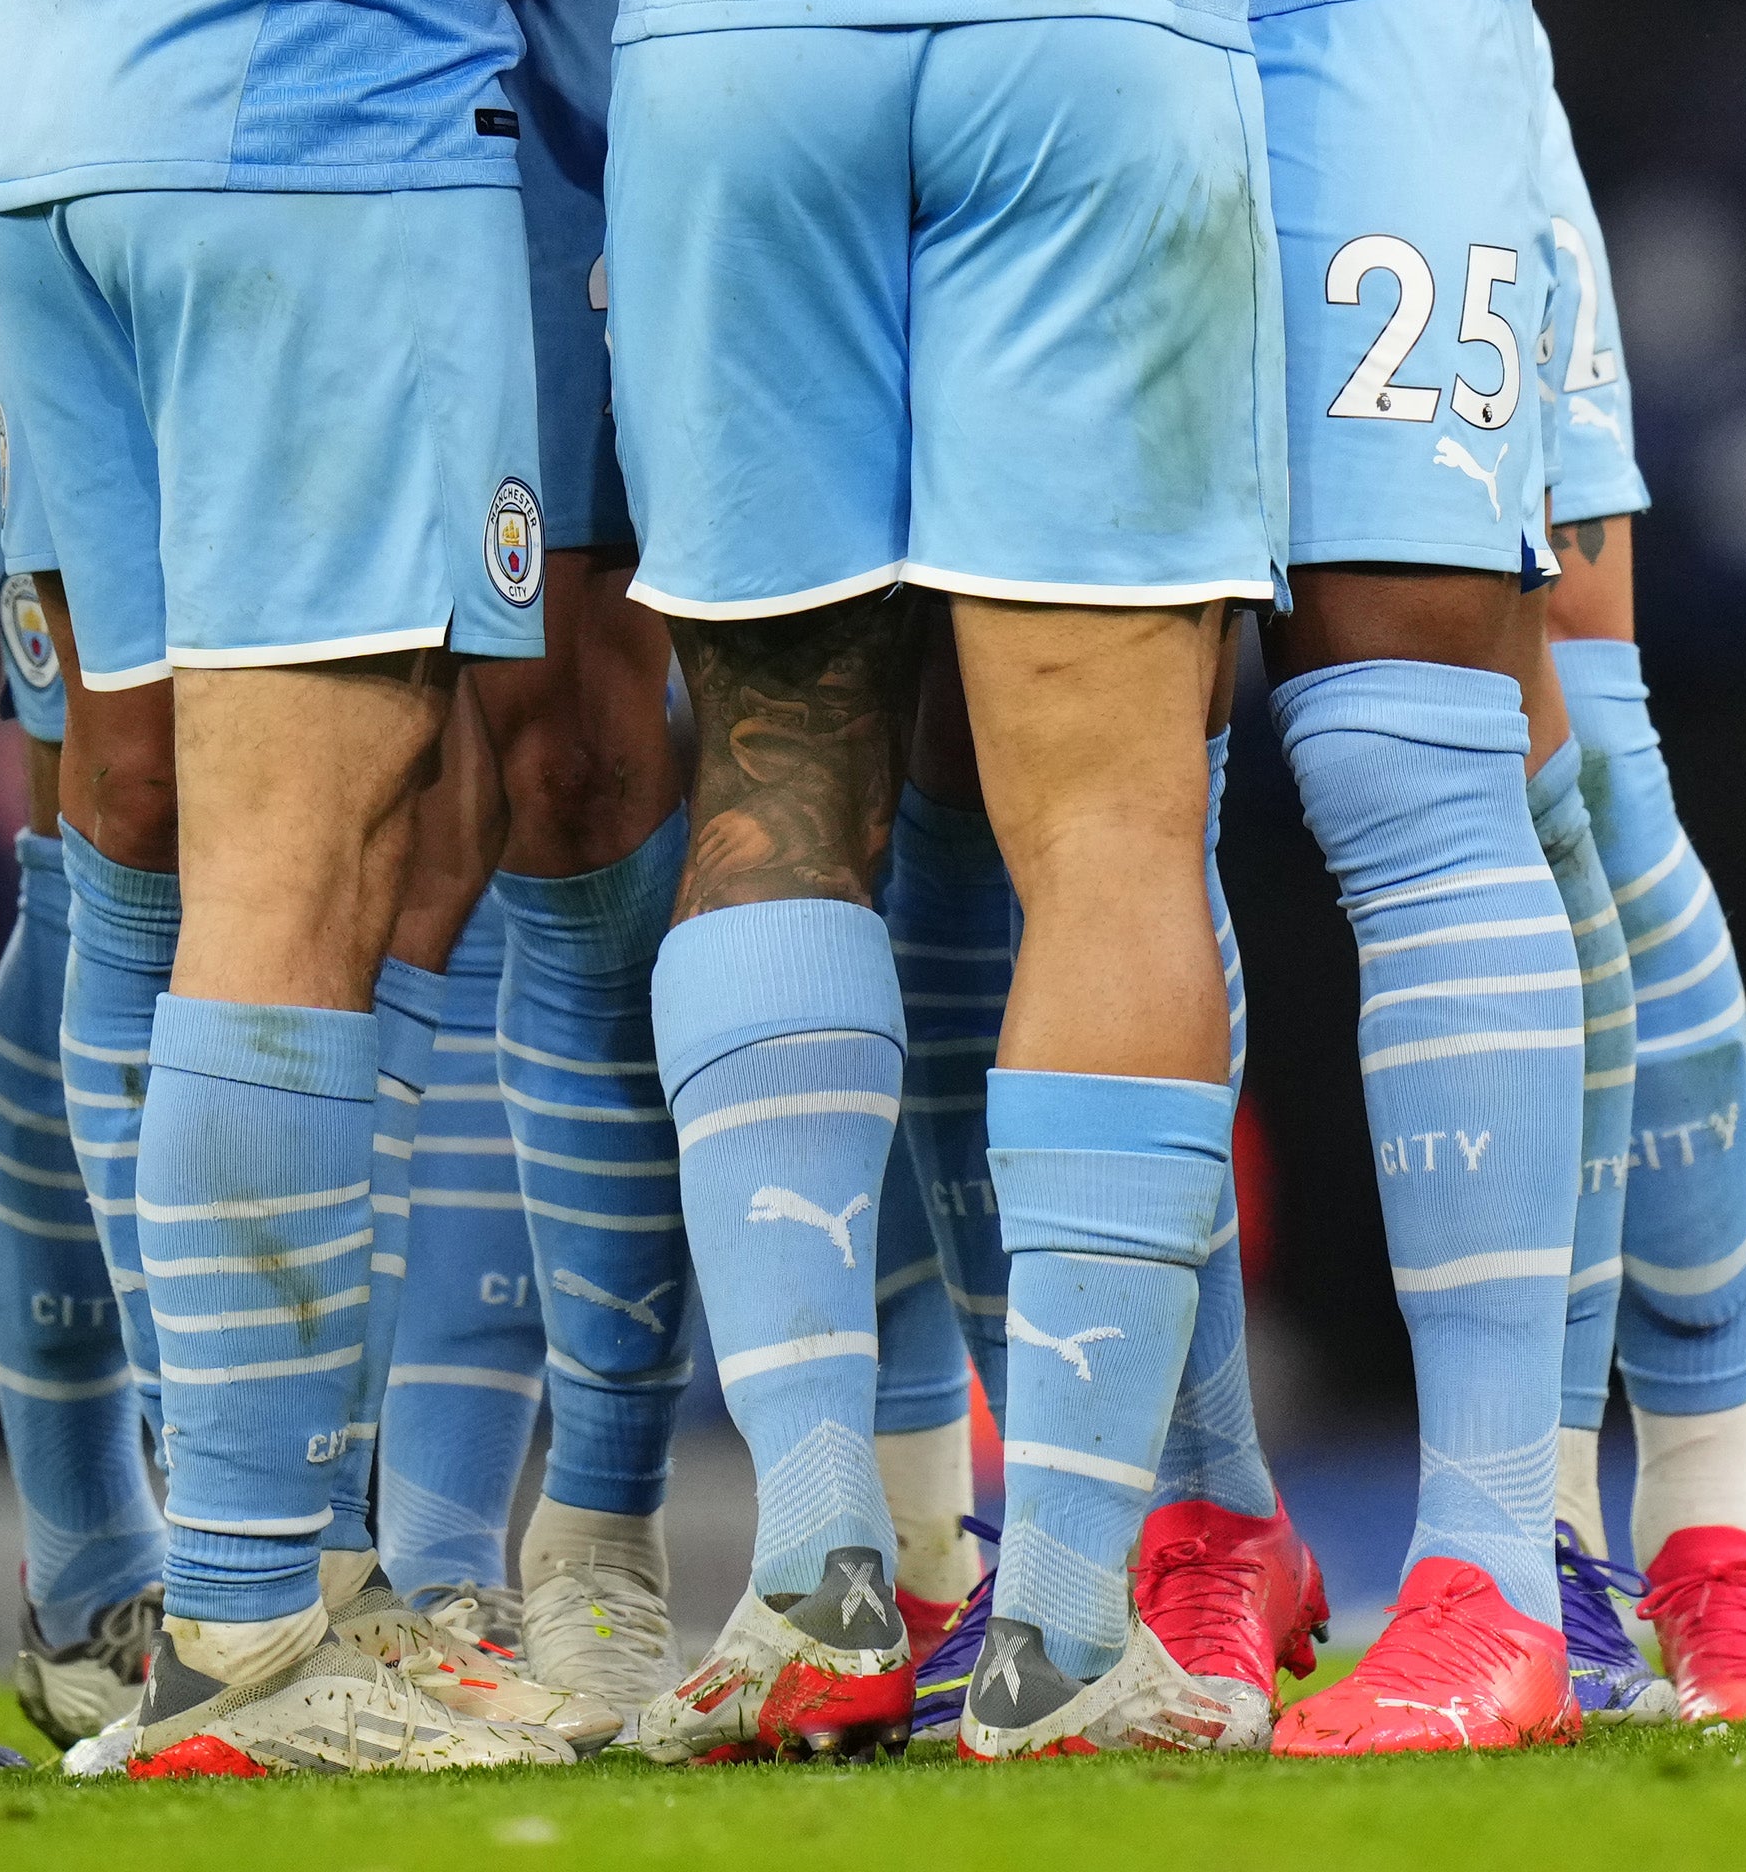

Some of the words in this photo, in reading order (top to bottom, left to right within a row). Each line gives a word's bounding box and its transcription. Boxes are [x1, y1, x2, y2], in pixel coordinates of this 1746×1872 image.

[1325, 234, 1521, 430] 25
[490, 486, 537, 527] MANCHESTER
[508, 585, 528, 597] CITY
[1380, 1129, 1491, 1176] CITY
[931, 1180, 998, 1216] CIT
[31, 1291, 115, 1327] CIT
